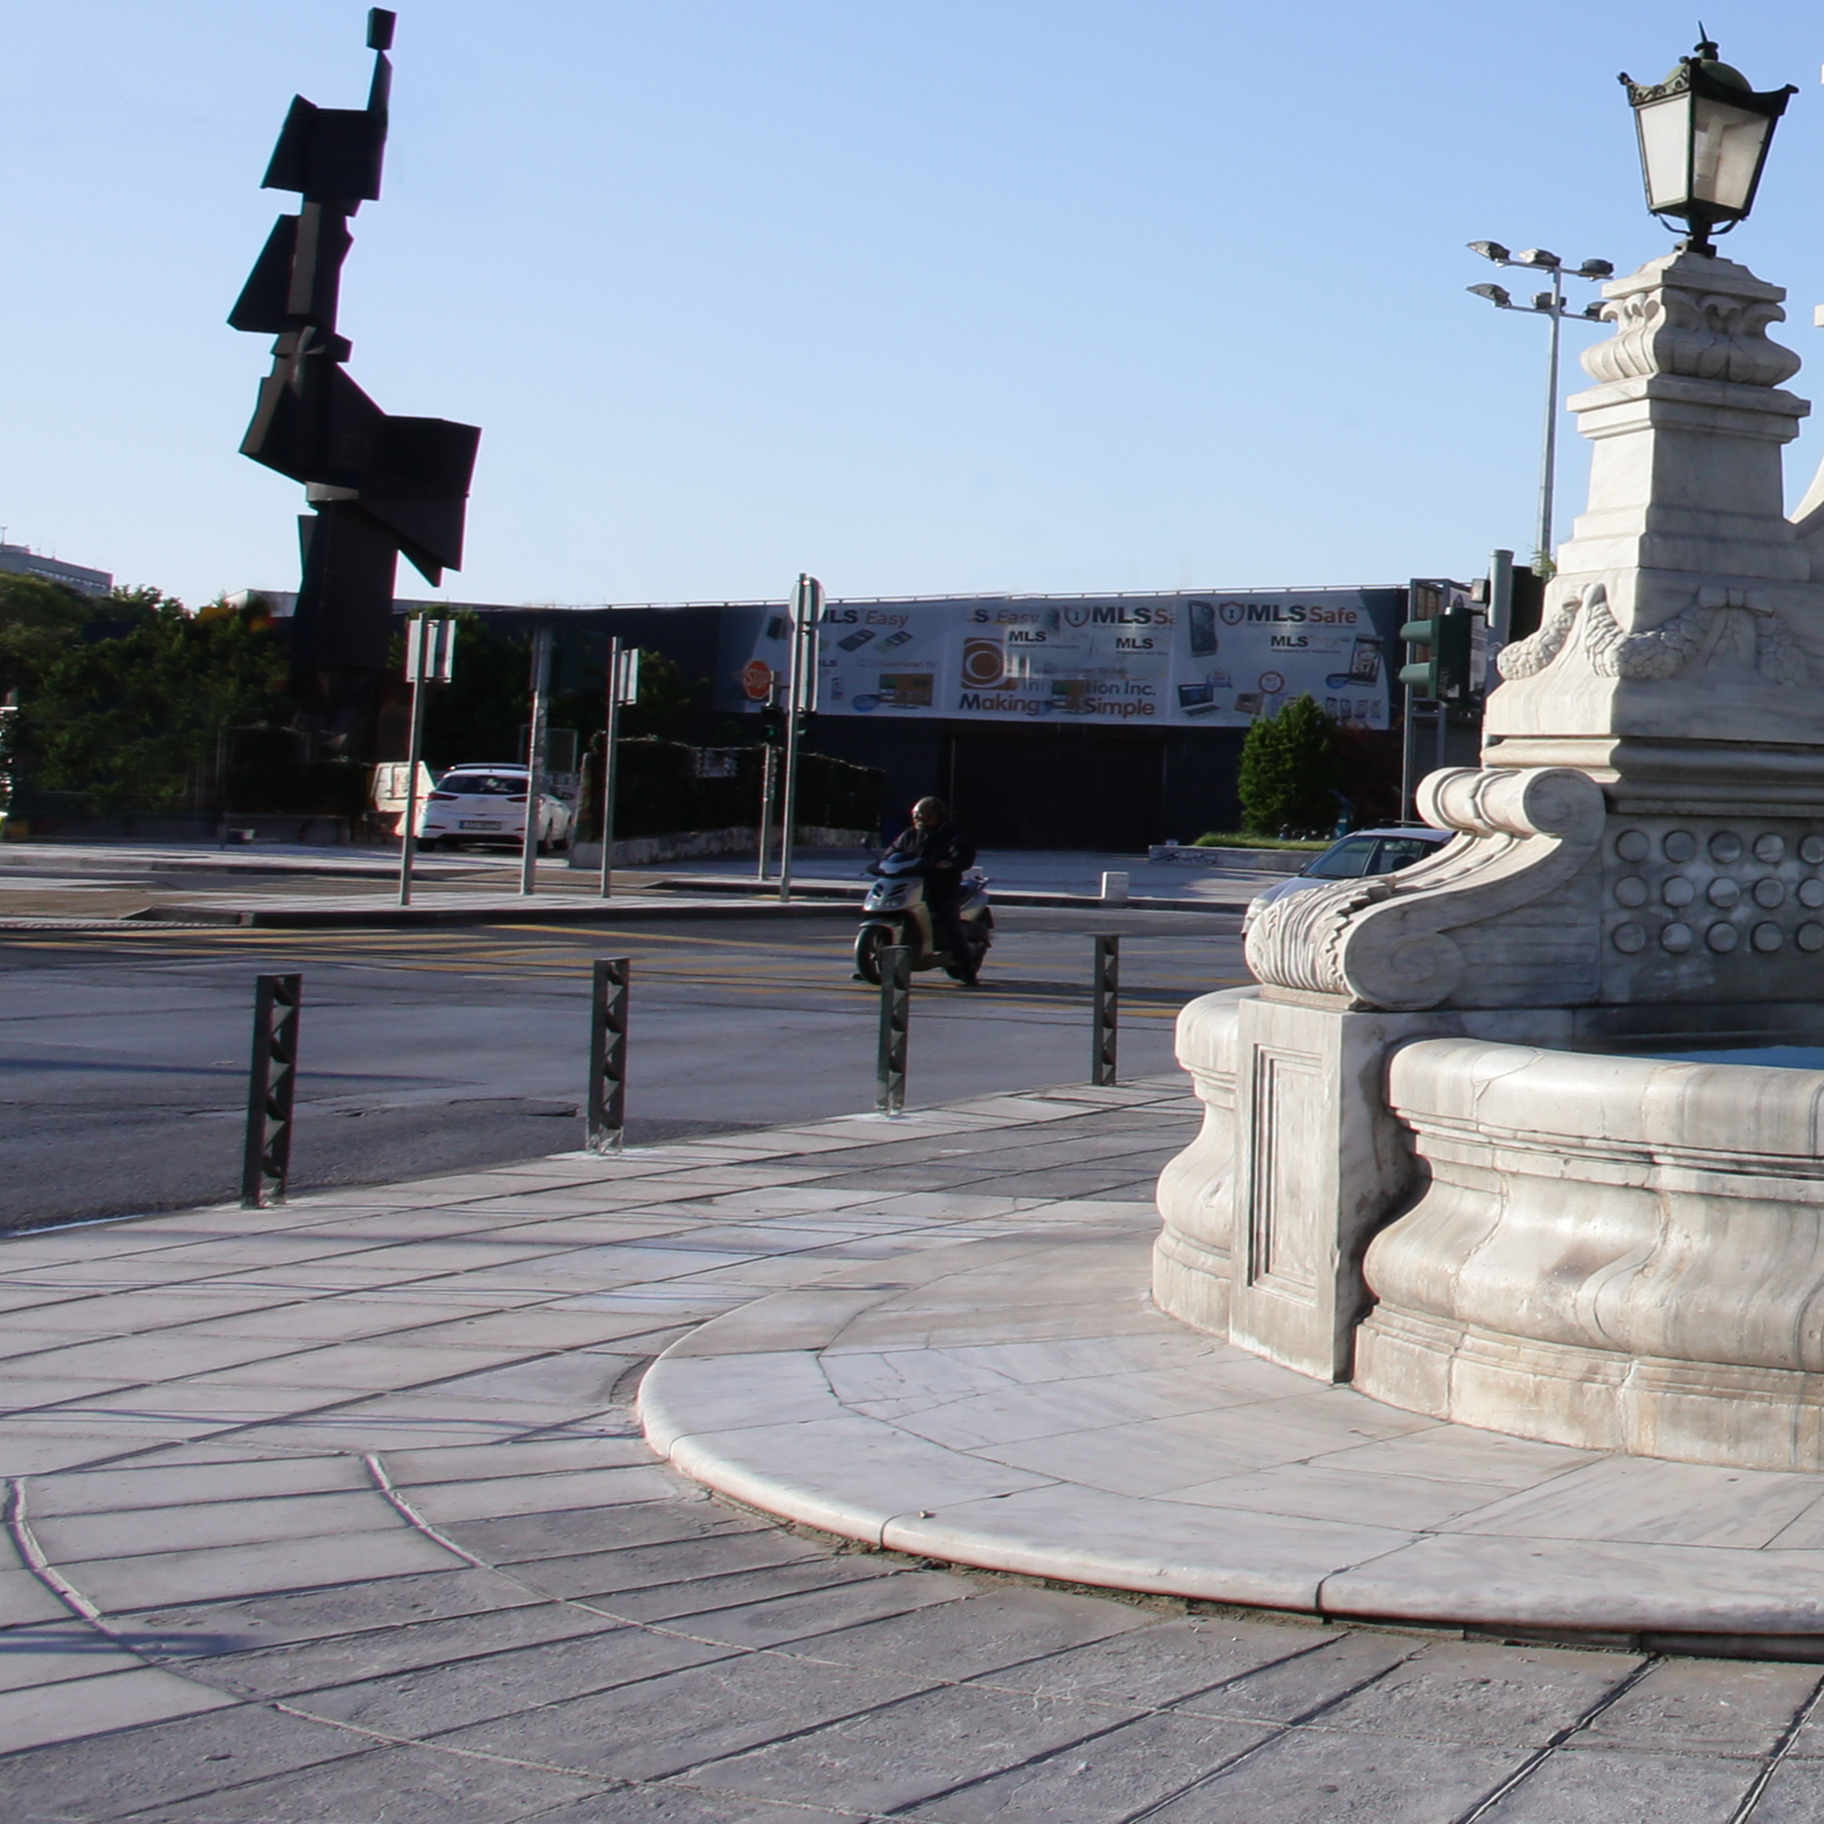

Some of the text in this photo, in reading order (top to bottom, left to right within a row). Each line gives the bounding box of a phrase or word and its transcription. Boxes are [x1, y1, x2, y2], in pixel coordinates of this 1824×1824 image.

[865, 610, 910, 628] Easy
[1092, 607, 1152, 624] MLS
[1247, 604, 1358, 624] MLS Safe
[1009, 631, 1047, 643] MLS
[1116, 638, 1154, 649] MLS
[1271, 635, 1309, 647] MLS
[959, 694, 1156, 718] Making Simple
